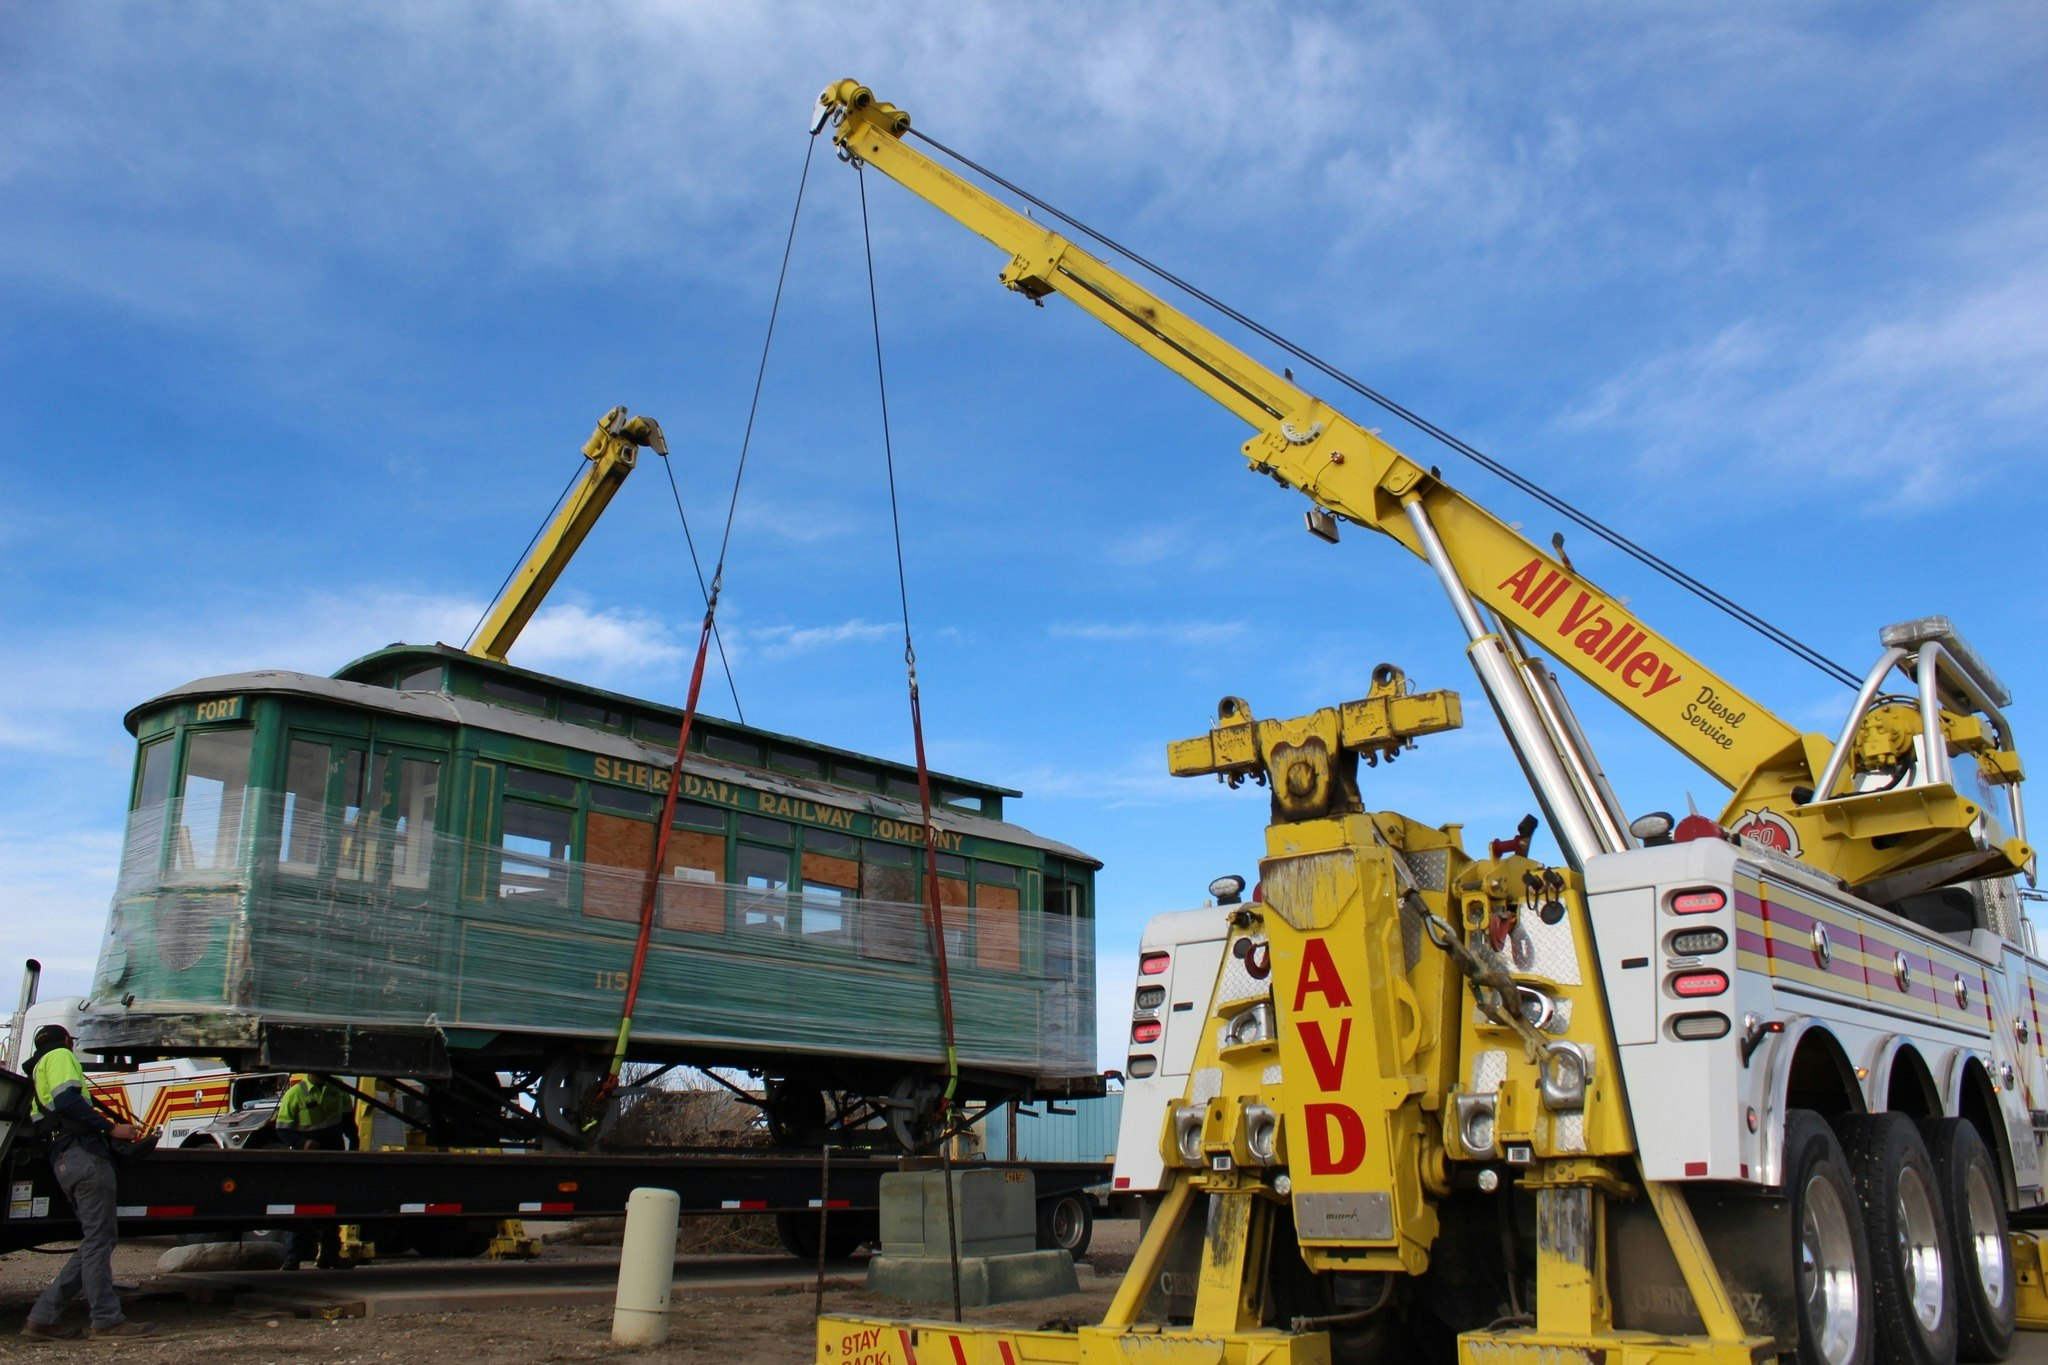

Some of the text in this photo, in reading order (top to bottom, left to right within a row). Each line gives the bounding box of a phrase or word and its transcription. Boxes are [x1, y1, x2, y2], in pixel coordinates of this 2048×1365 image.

[1496, 557, 1682, 698] All Valley
[197, 697, 238, 721] FORT
[1681, 703, 1733, 750] Service
[1696, 686, 1746, 729] Diesel
[594, 757, 738, 805] SHERDAN
[758, 792, 854, 830] RAILWAY
[1747, 828, 1774, 845] 50
[595, 970, 629, 992] 115
[1293, 938, 1366, 1175] AVD
[842, 1328, 881, 1356] STAY
